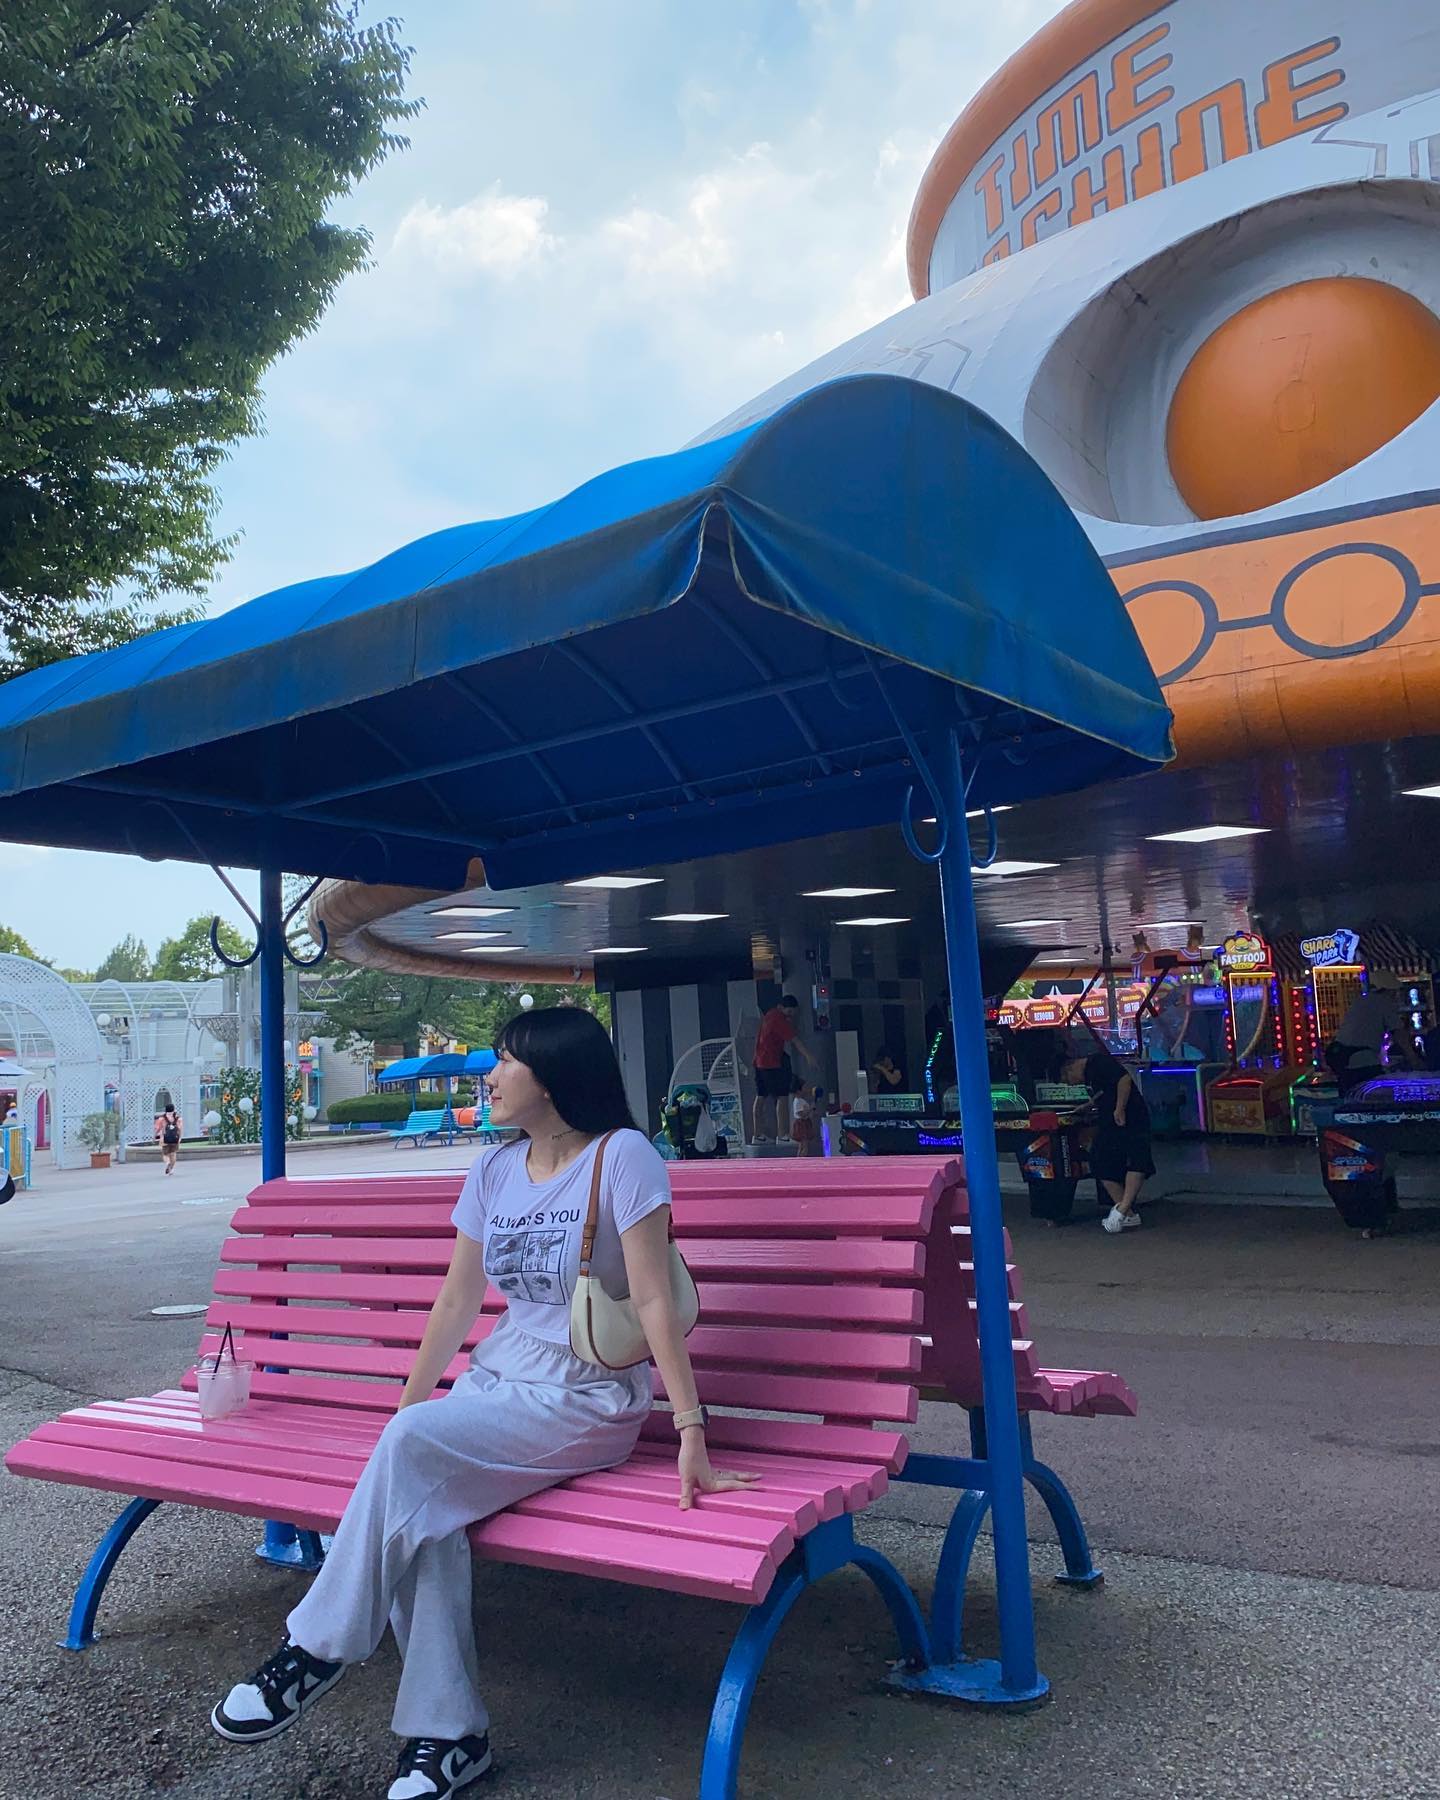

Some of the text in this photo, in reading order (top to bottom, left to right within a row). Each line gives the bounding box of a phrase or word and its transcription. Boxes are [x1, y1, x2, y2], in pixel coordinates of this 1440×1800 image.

[974, 21, 1175, 235] TIME
[981, 36, 1350, 269] CHINE
[1302, 938, 1335, 954] SHARK
[1221, 951, 1266, 966] FAST FOOD
[1316, 948, 1338, 963] PARK
[550, 1208, 580, 1224] YOU
